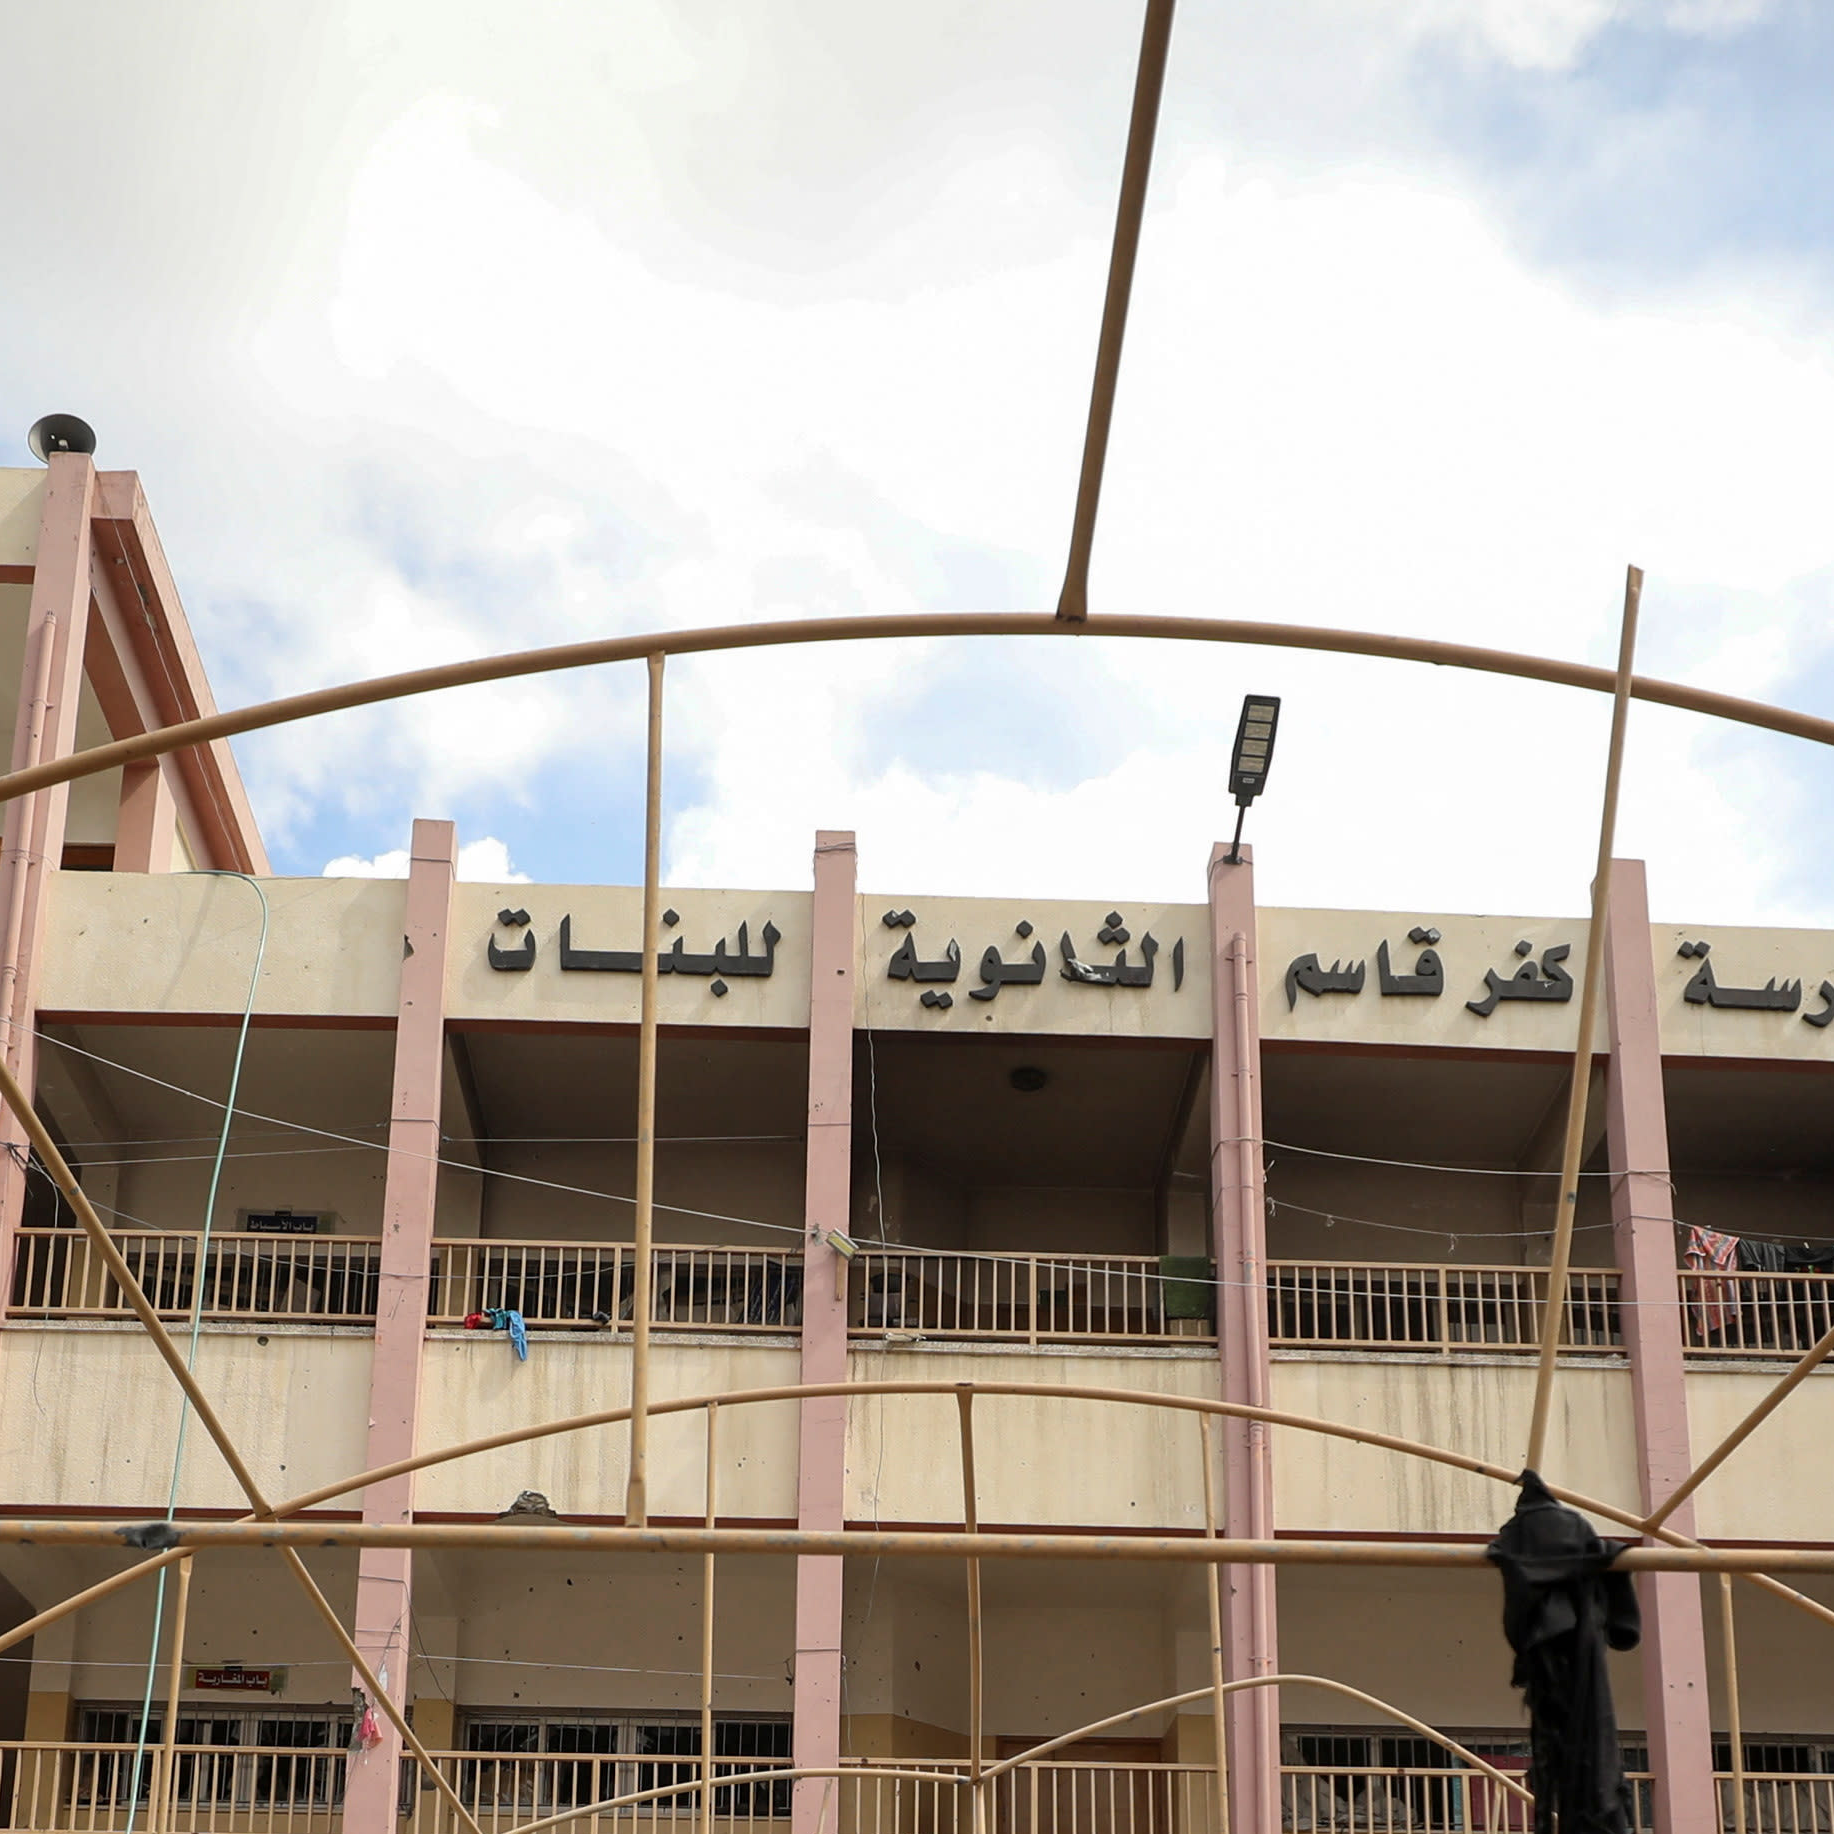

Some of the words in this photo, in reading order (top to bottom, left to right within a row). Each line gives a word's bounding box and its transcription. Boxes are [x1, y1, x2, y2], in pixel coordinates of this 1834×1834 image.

[488, 909, 783, 998] للبنات
[883, 910, 1184, 1011] الثانوية
[1285, 927, 1443, 1012] قاسم
[1465, 940, 1574, 1019] كفر
[246, 1674, 268, 1687] باب
